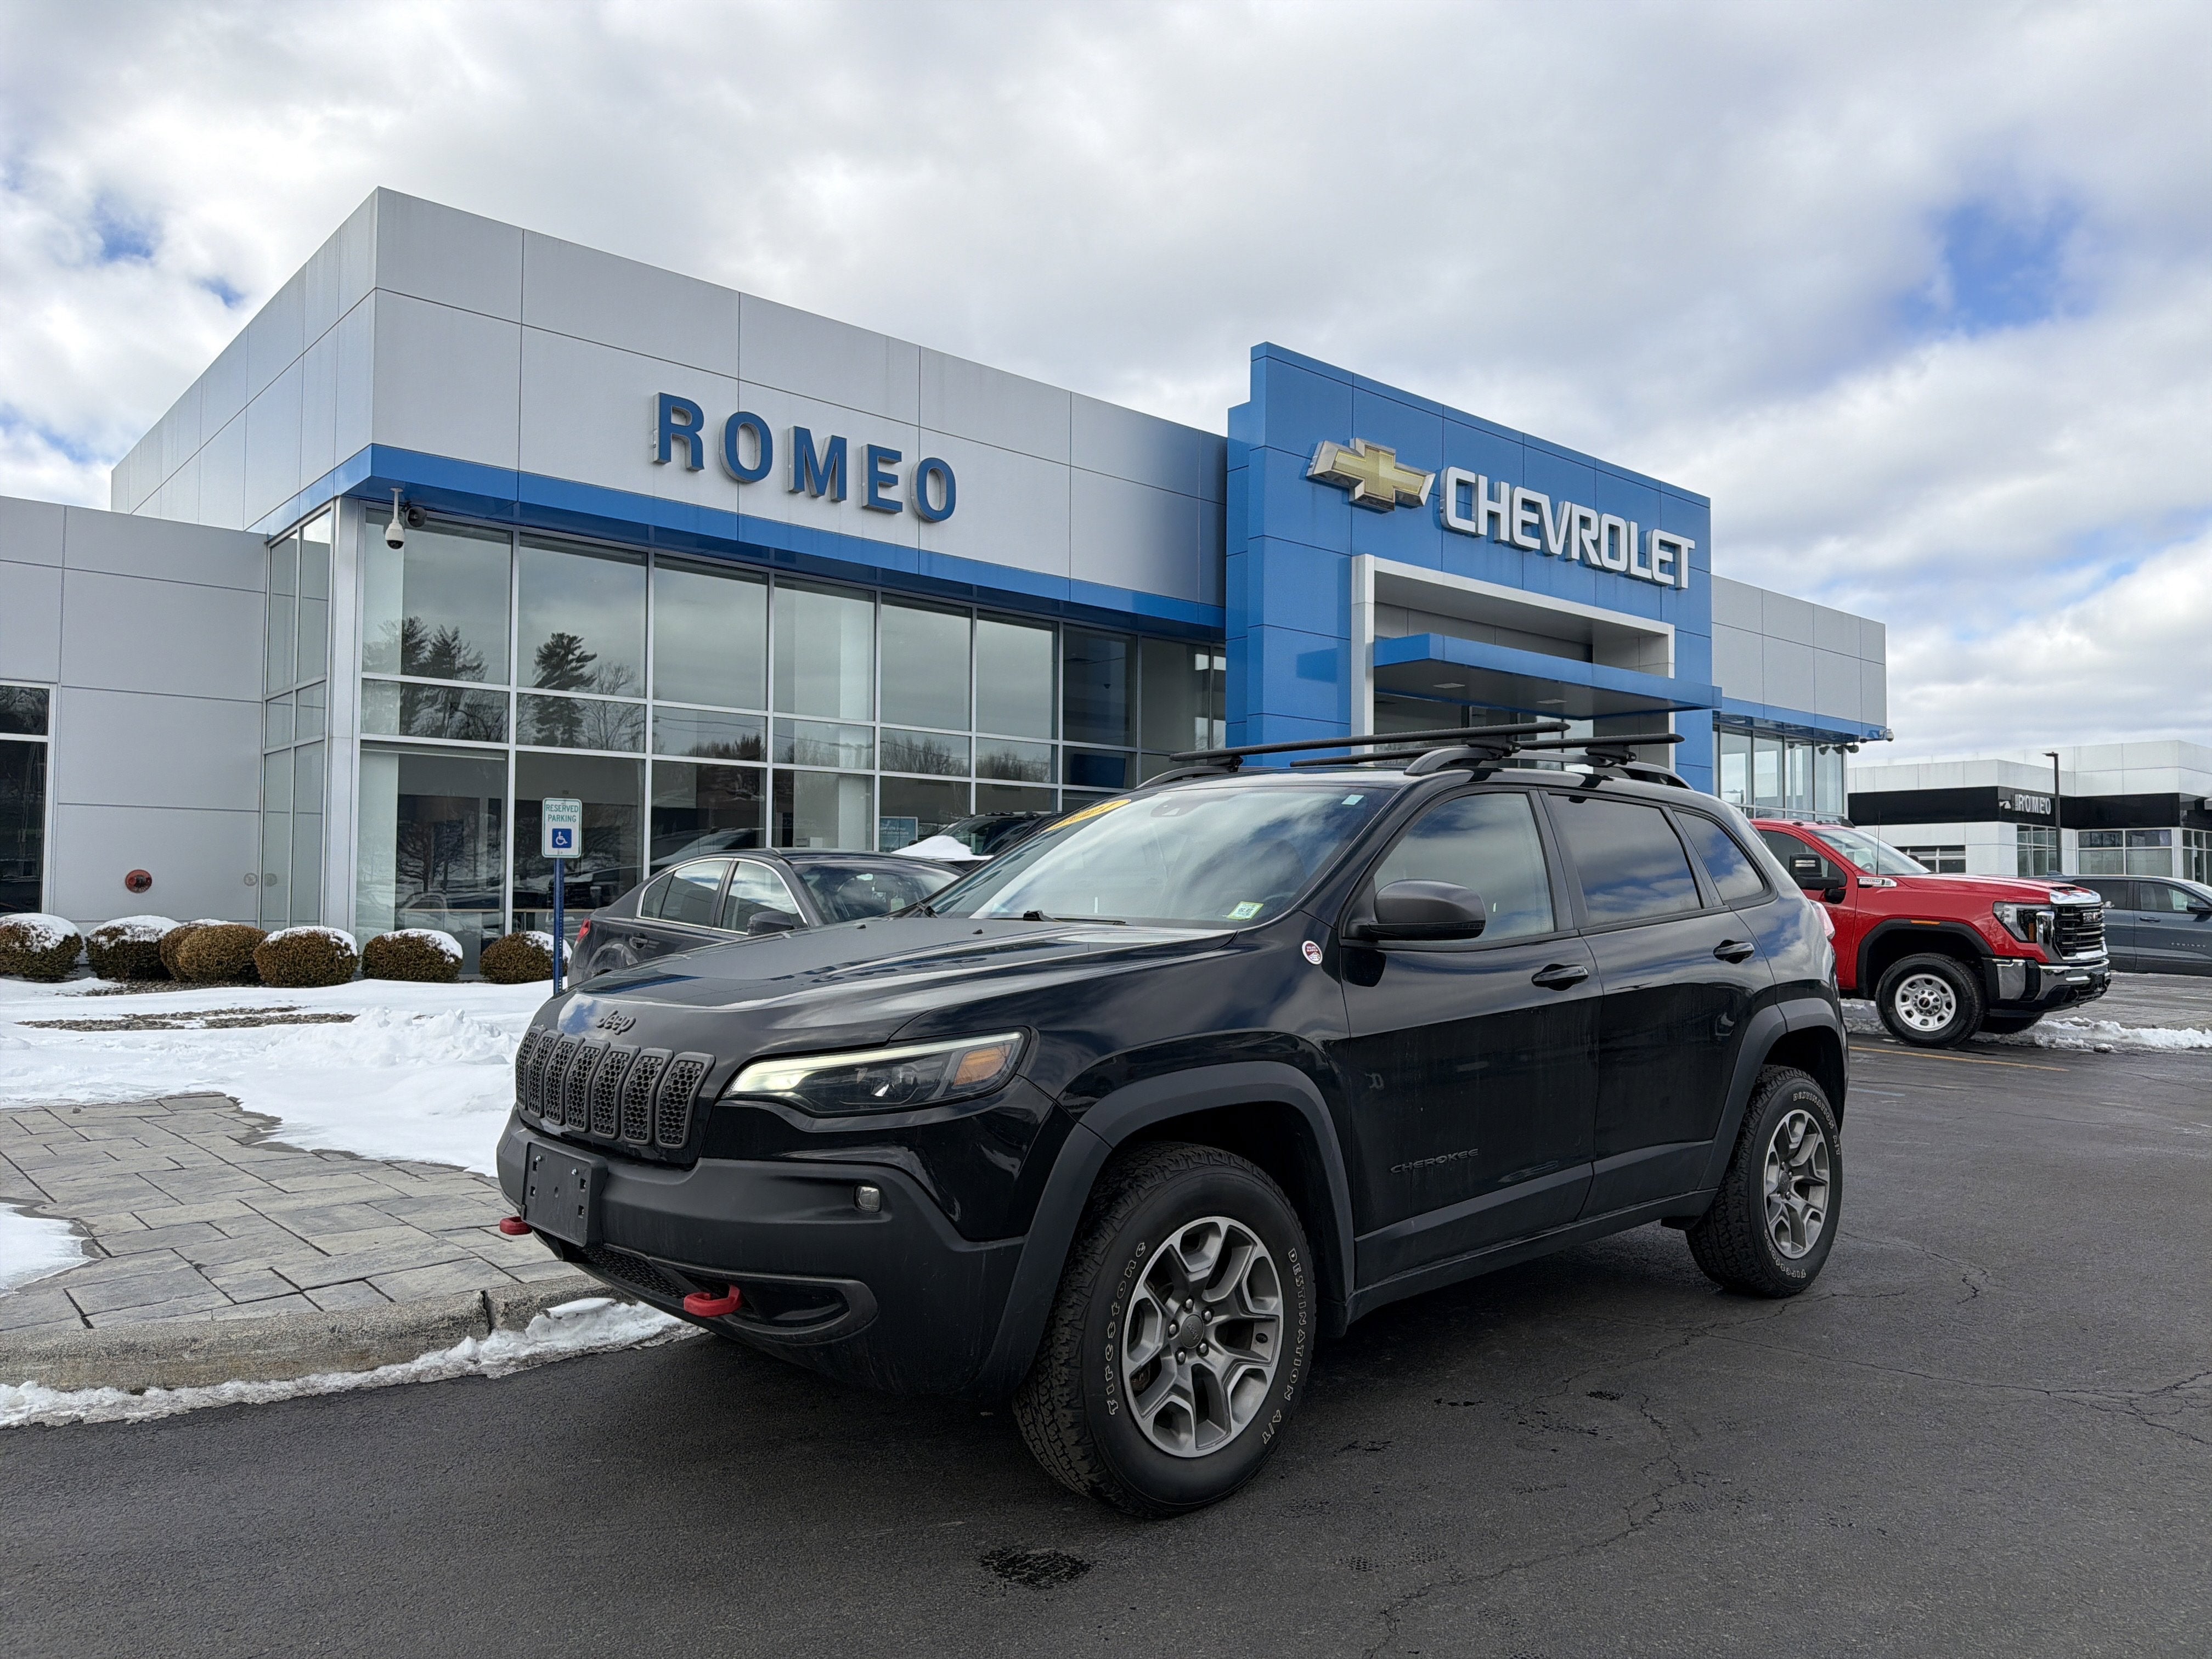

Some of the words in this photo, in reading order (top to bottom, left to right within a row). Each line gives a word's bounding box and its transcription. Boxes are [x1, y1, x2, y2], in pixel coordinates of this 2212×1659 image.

[653, 392, 957, 522] ROMEO
[1441, 466, 1695, 589] CHEVROLET
[546, 804, 579, 812] RESERVED
[548, 814, 577, 823] PARKING
[2015, 794, 2051, 815] ROMEO
[596, 1009, 636, 1036] Jeep
[1793, 1091, 1835, 1129] DESTINATION
[1390, 1148, 1479, 1173] CHEROKEE
[1104, 1242, 1146, 1415] Firestone
[1284, 1248, 1307, 1401] DESTINATION
[1261, 1409, 1282, 1444] A/T
